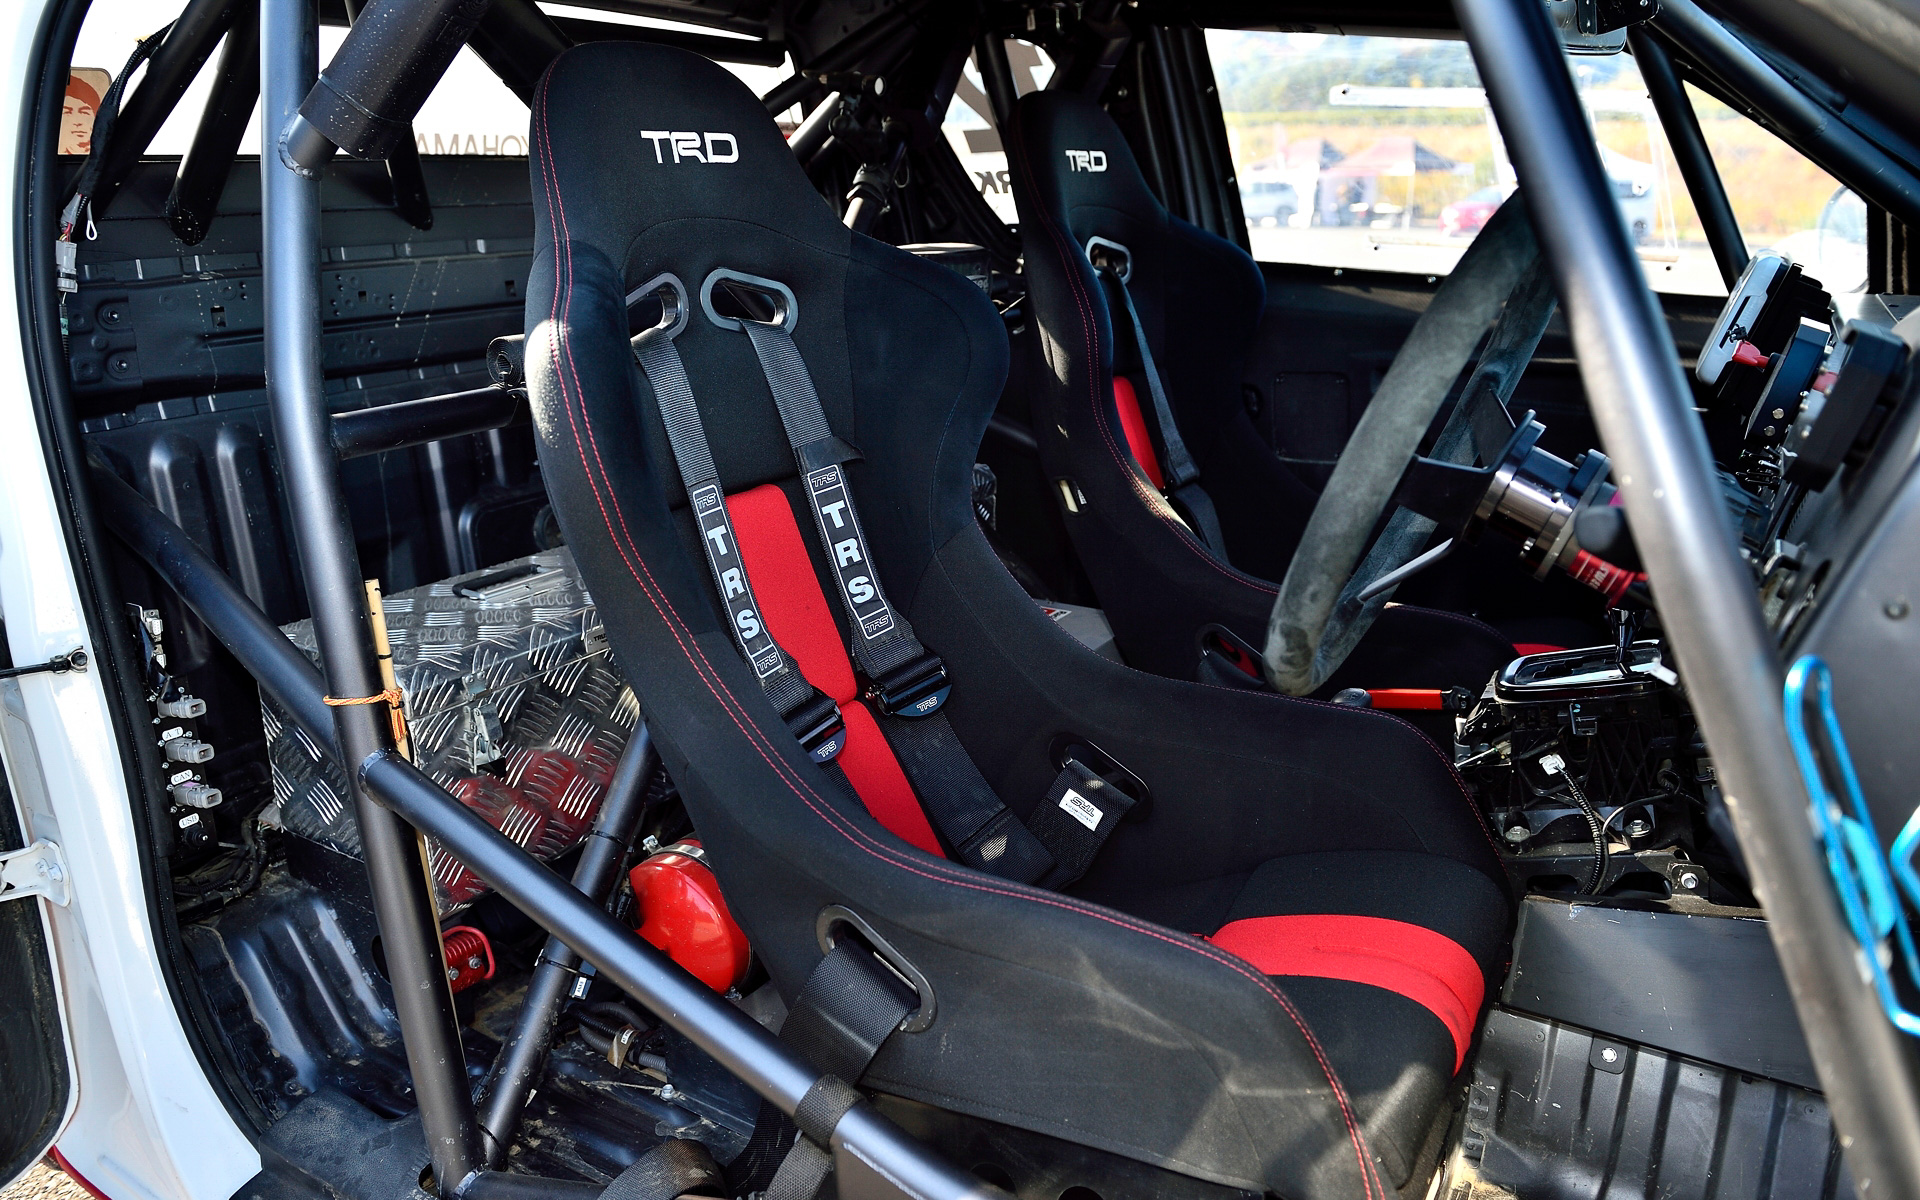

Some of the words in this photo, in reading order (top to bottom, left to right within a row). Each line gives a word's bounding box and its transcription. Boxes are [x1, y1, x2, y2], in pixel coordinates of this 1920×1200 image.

[640, 130, 739, 164] TRD
[1065, 149, 1108, 172] TRD
[811, 471, 838, 488] TRS
[696, 493, 717, 509] TRS
[821, 500, 875, 604] TRS
[706, 524, 760, 640] TRS
[864, 615, 889, 633] TRS
[756, 652, 778, 671] TRS
[916, 696, 938, 712] TRS
[817, 740, 837, 757] TRS
[173, 772, 191, 783] CAN
[1070, 796, 1094, 818] TRS
[181, 815, 198, 826] USB
